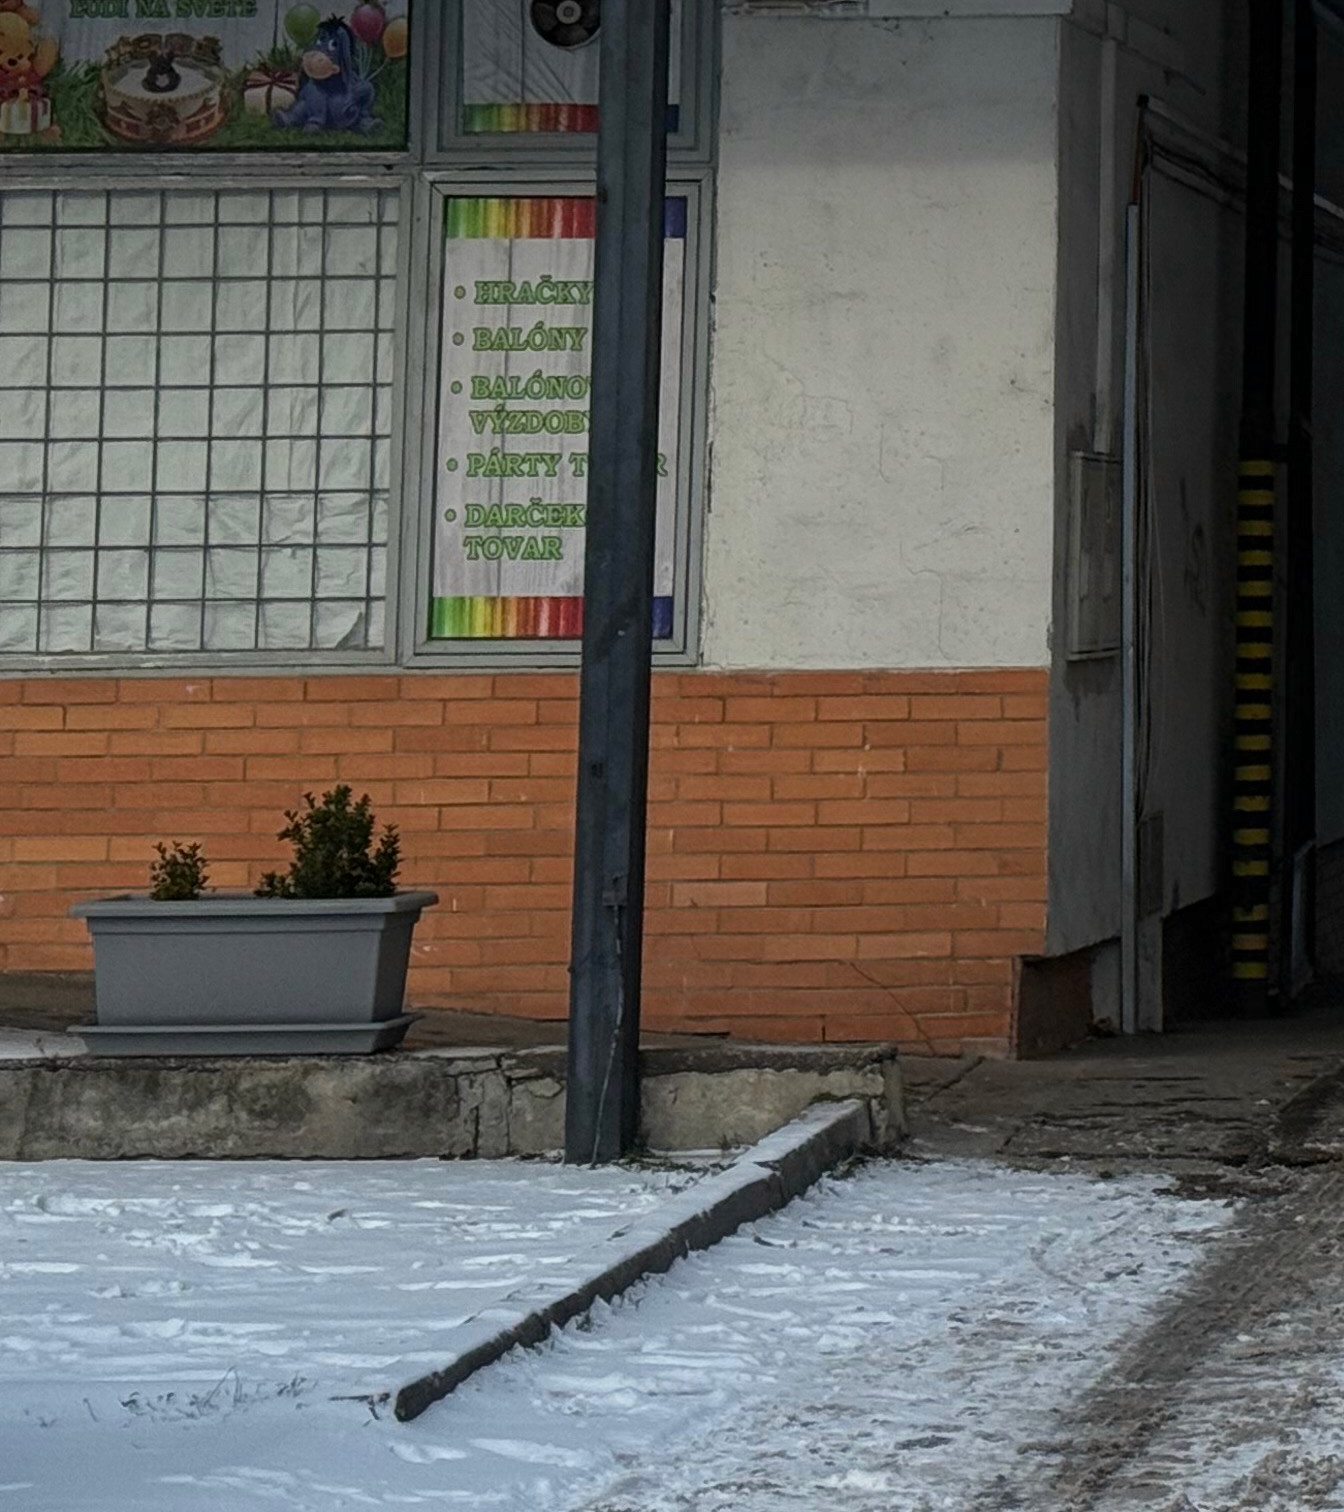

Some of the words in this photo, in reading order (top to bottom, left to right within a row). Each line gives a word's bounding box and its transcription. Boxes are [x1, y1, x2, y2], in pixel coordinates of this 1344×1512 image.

[474, 275, 594, 305] HRAČKY
[472, 321, 588, 351] BALÓNY
[471, 369, 591, 400] BALÓNO
[469, 404, 591, 433] VÝZDOB
[466, 447, 561, 477] PÁRTY
[464, 497, 586, 528] DARČEK
[463, 536, 563, 560] TOVAR
